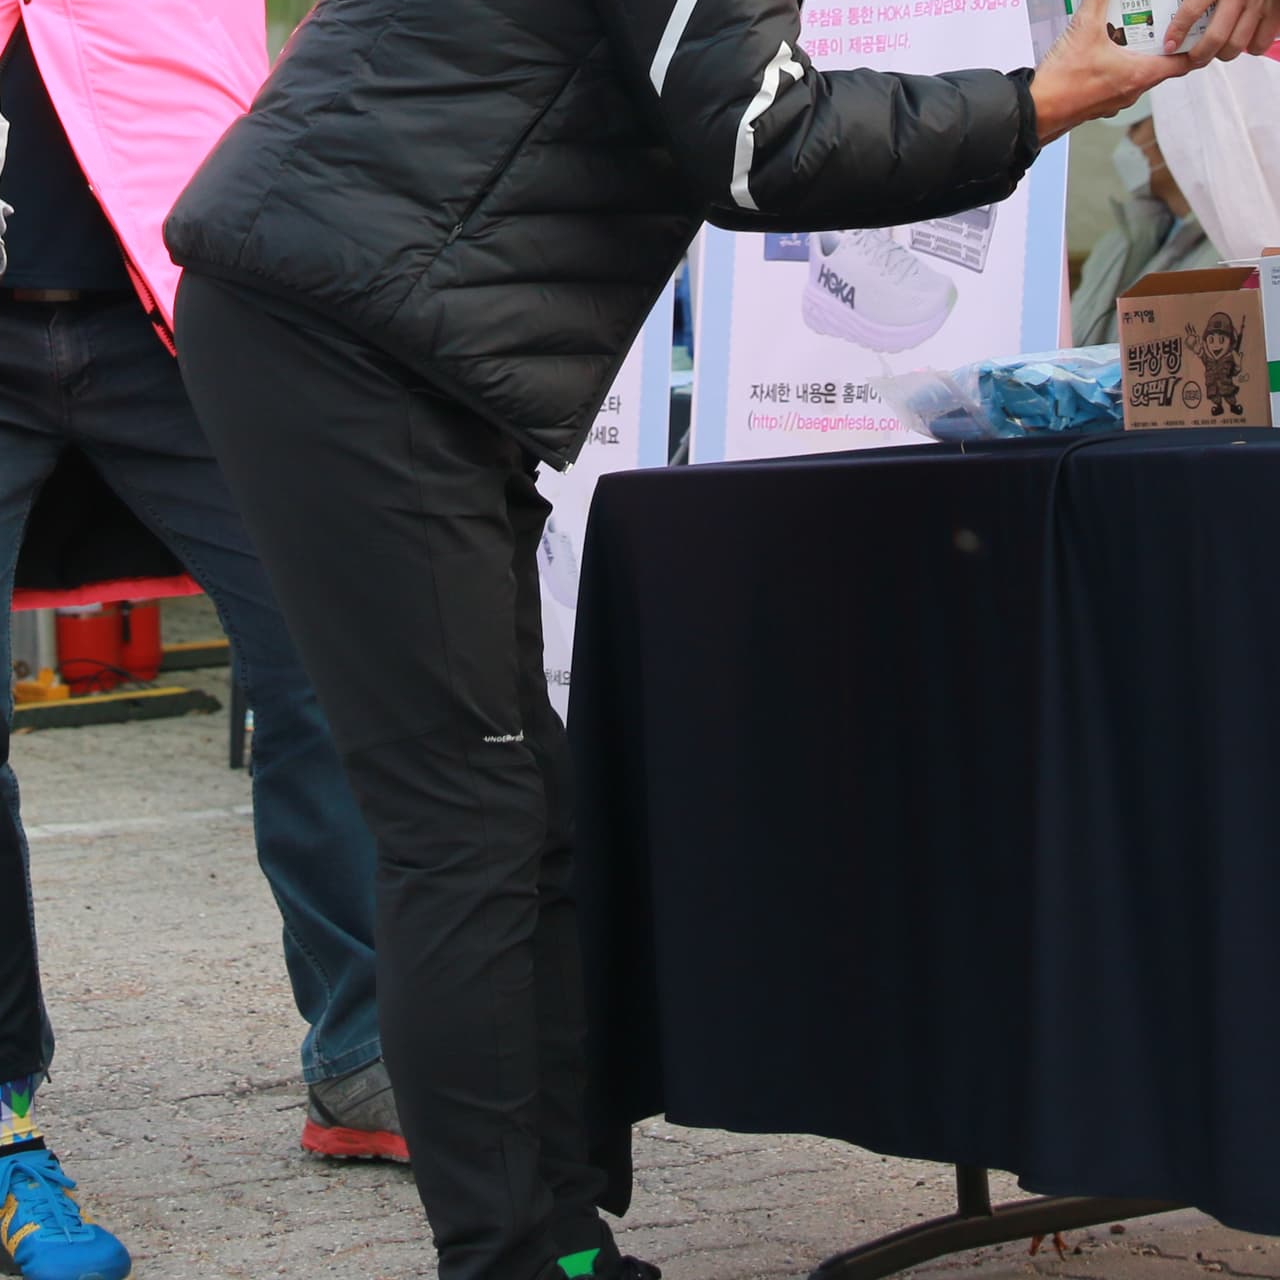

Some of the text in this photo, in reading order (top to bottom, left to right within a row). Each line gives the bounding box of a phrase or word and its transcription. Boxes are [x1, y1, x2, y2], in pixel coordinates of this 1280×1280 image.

[848, 5, 874, 26] 통한
[877, 4, 911, 21] HOKA
[804, 37, 844, 57] 경품이
[817, 263, 856, 310] HOKA
[1127, 336, 1183, 377] 박상병
[750, 382, 791, 403] 자세한
[796, 381, 837, 404] 내용은
